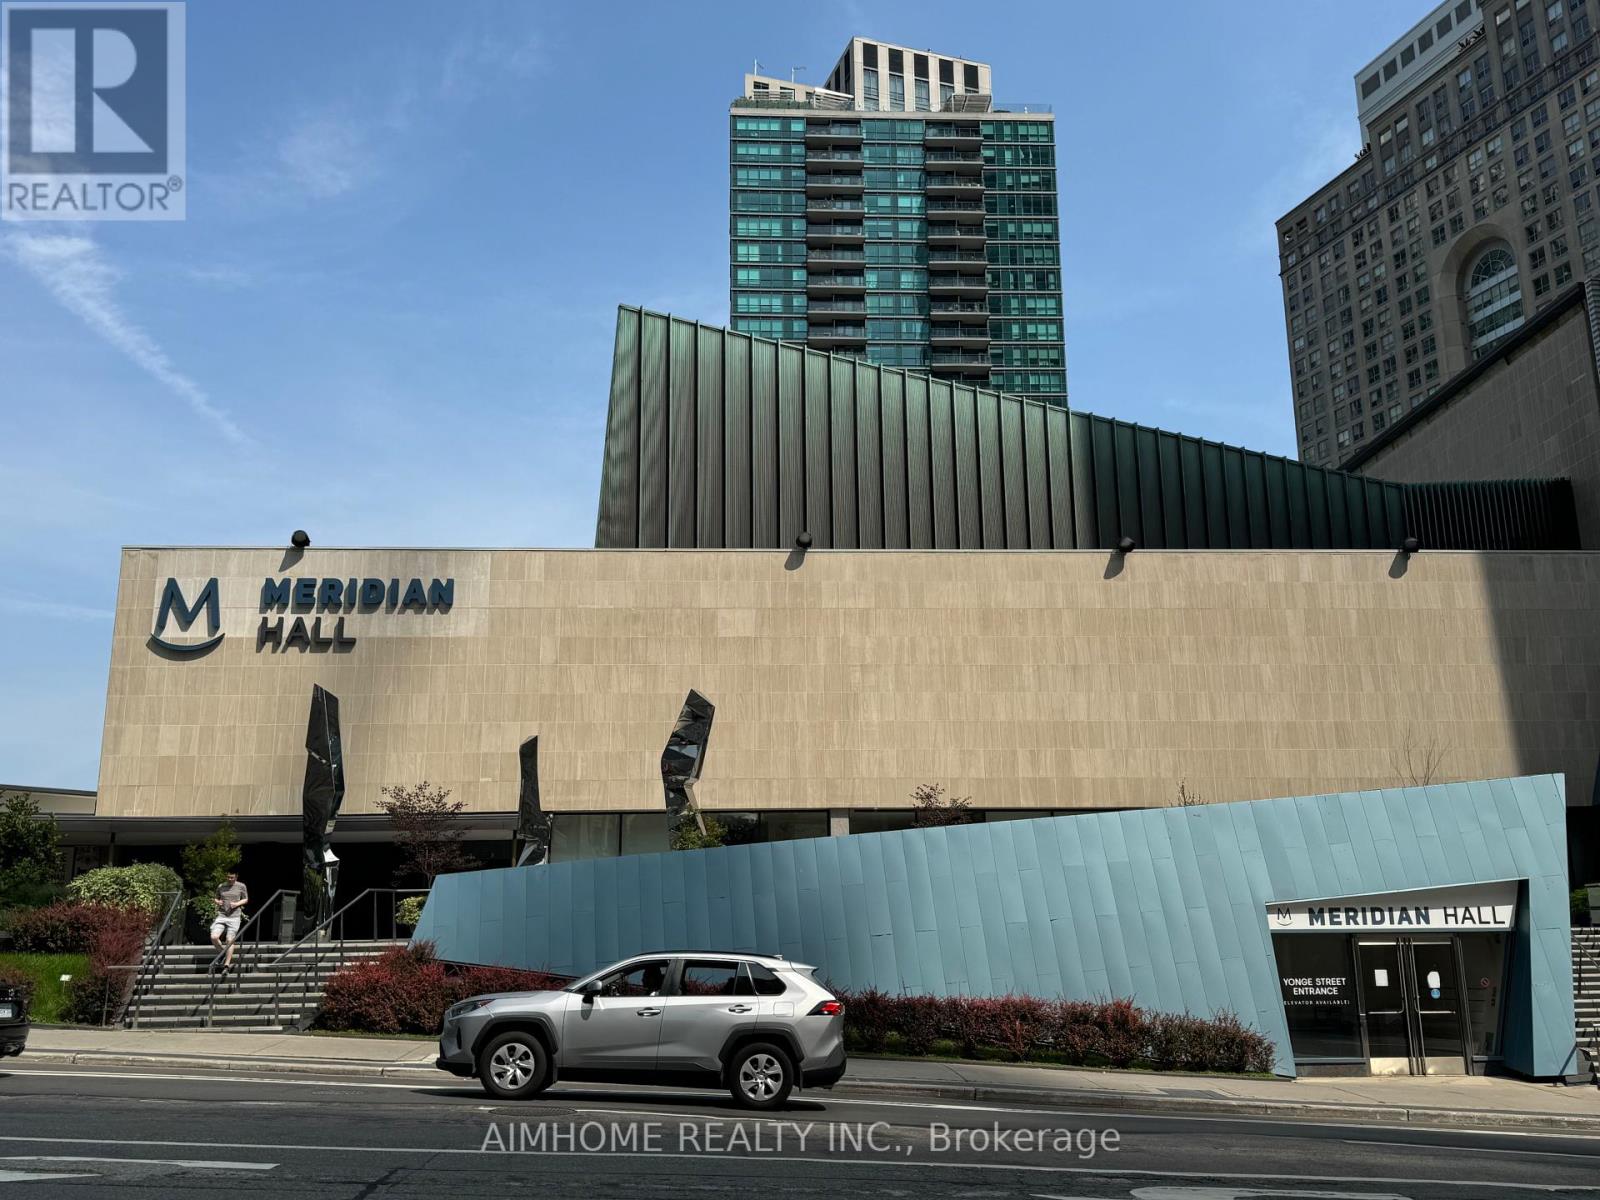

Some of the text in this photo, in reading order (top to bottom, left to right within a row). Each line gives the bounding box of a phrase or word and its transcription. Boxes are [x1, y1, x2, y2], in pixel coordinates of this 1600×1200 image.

[262, 577, 455, 609] MERIDIAN
[261, 616, 357, 647] HALL
[1308, 906, 1430, 926] MERIDIAN
[1443, 906, 1505, 924] HALL
[1283, 977, 1346, 986] YONGE STREET
[1293, 987, 1338, 995] ENTRANCE
